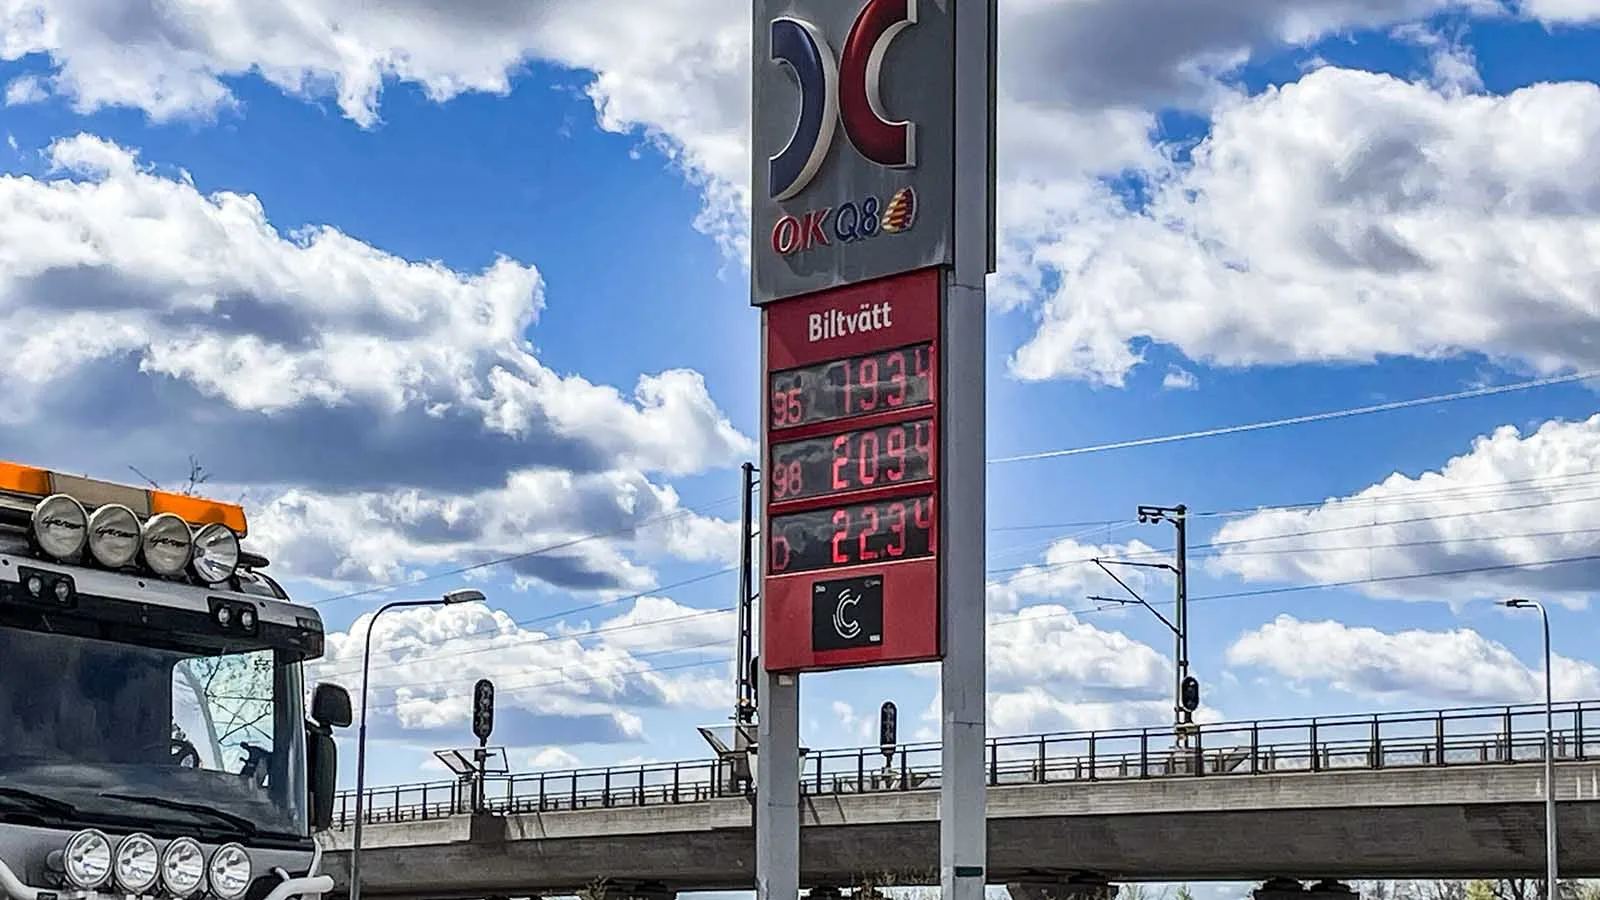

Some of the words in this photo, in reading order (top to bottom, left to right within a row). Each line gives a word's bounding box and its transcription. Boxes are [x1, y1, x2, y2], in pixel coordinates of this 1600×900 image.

[808, 302, 892, 342] Biltvätt
[773, 388, 802, 426] 95
[772, 460, 802, 498] 98
[772, 536, 790, 570] D
